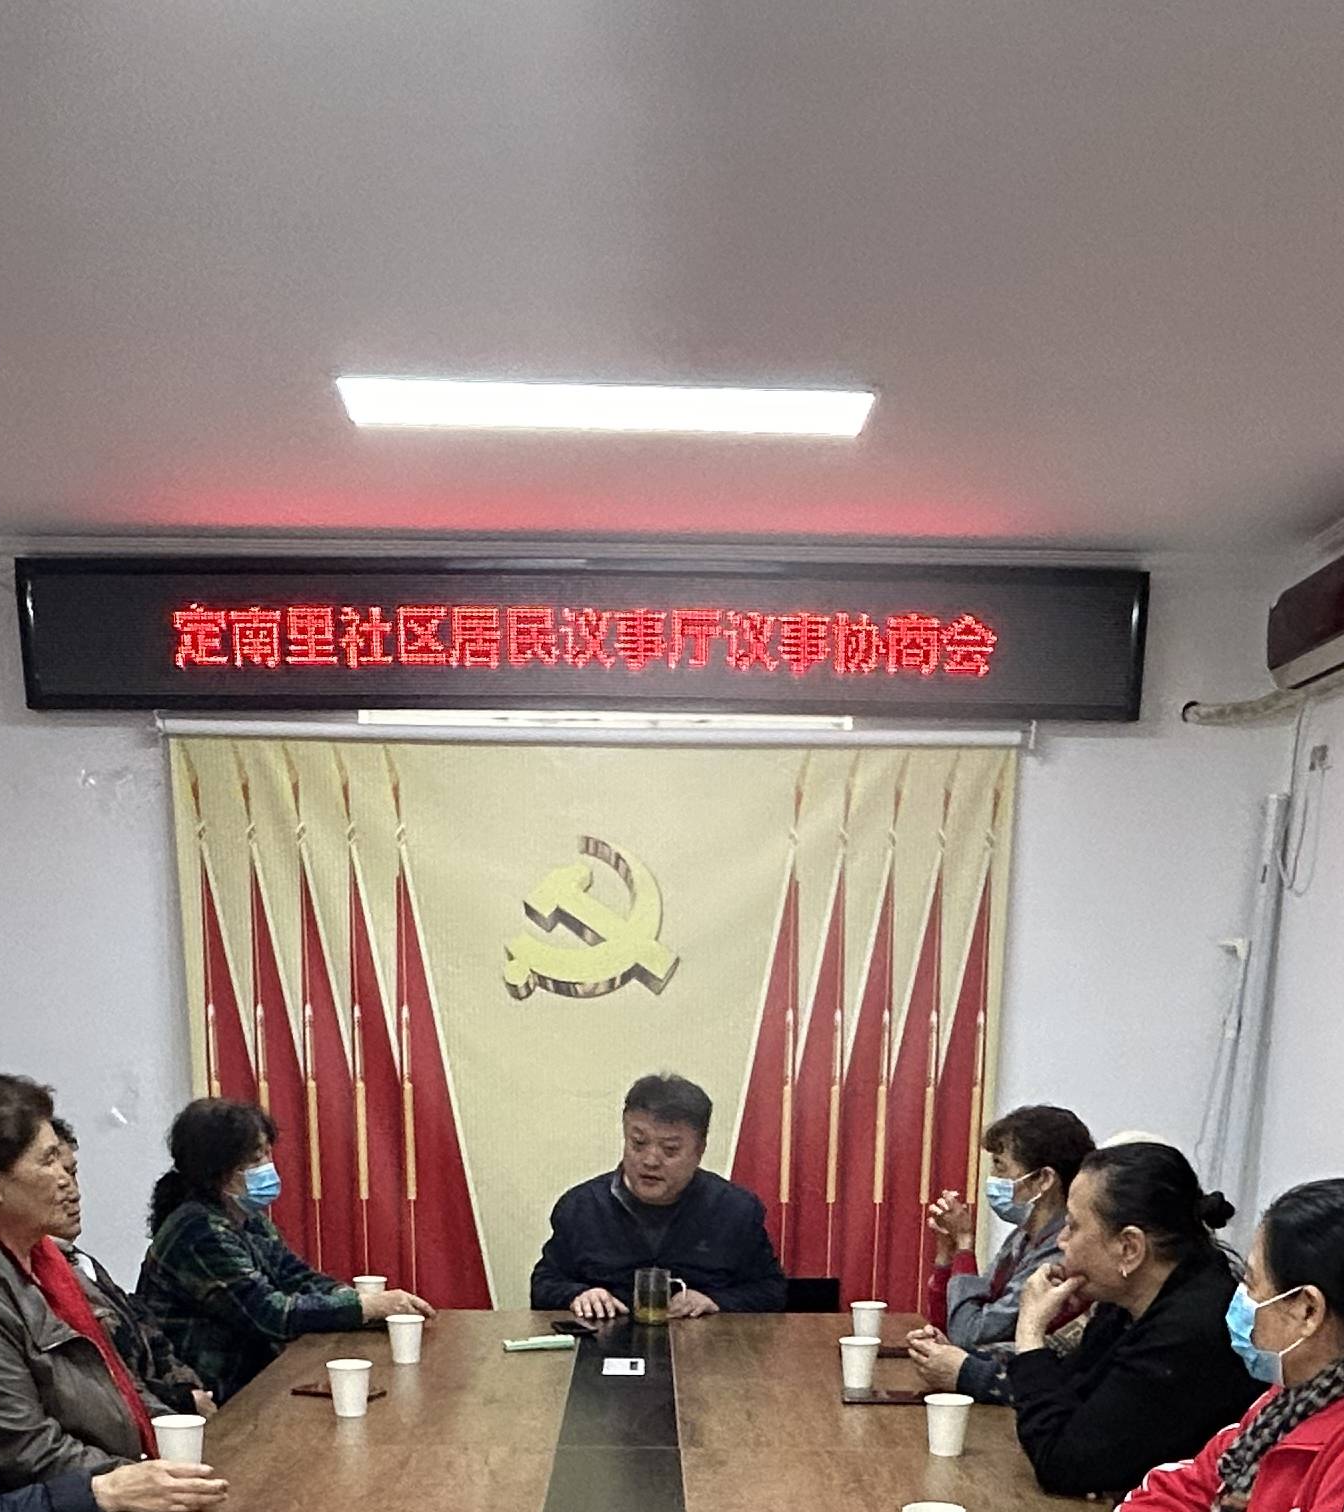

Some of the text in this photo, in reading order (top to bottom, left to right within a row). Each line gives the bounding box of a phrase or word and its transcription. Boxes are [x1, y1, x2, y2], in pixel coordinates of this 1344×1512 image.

[172, 602, 997, 677] 定南里社区居民议事厅议事协商会
